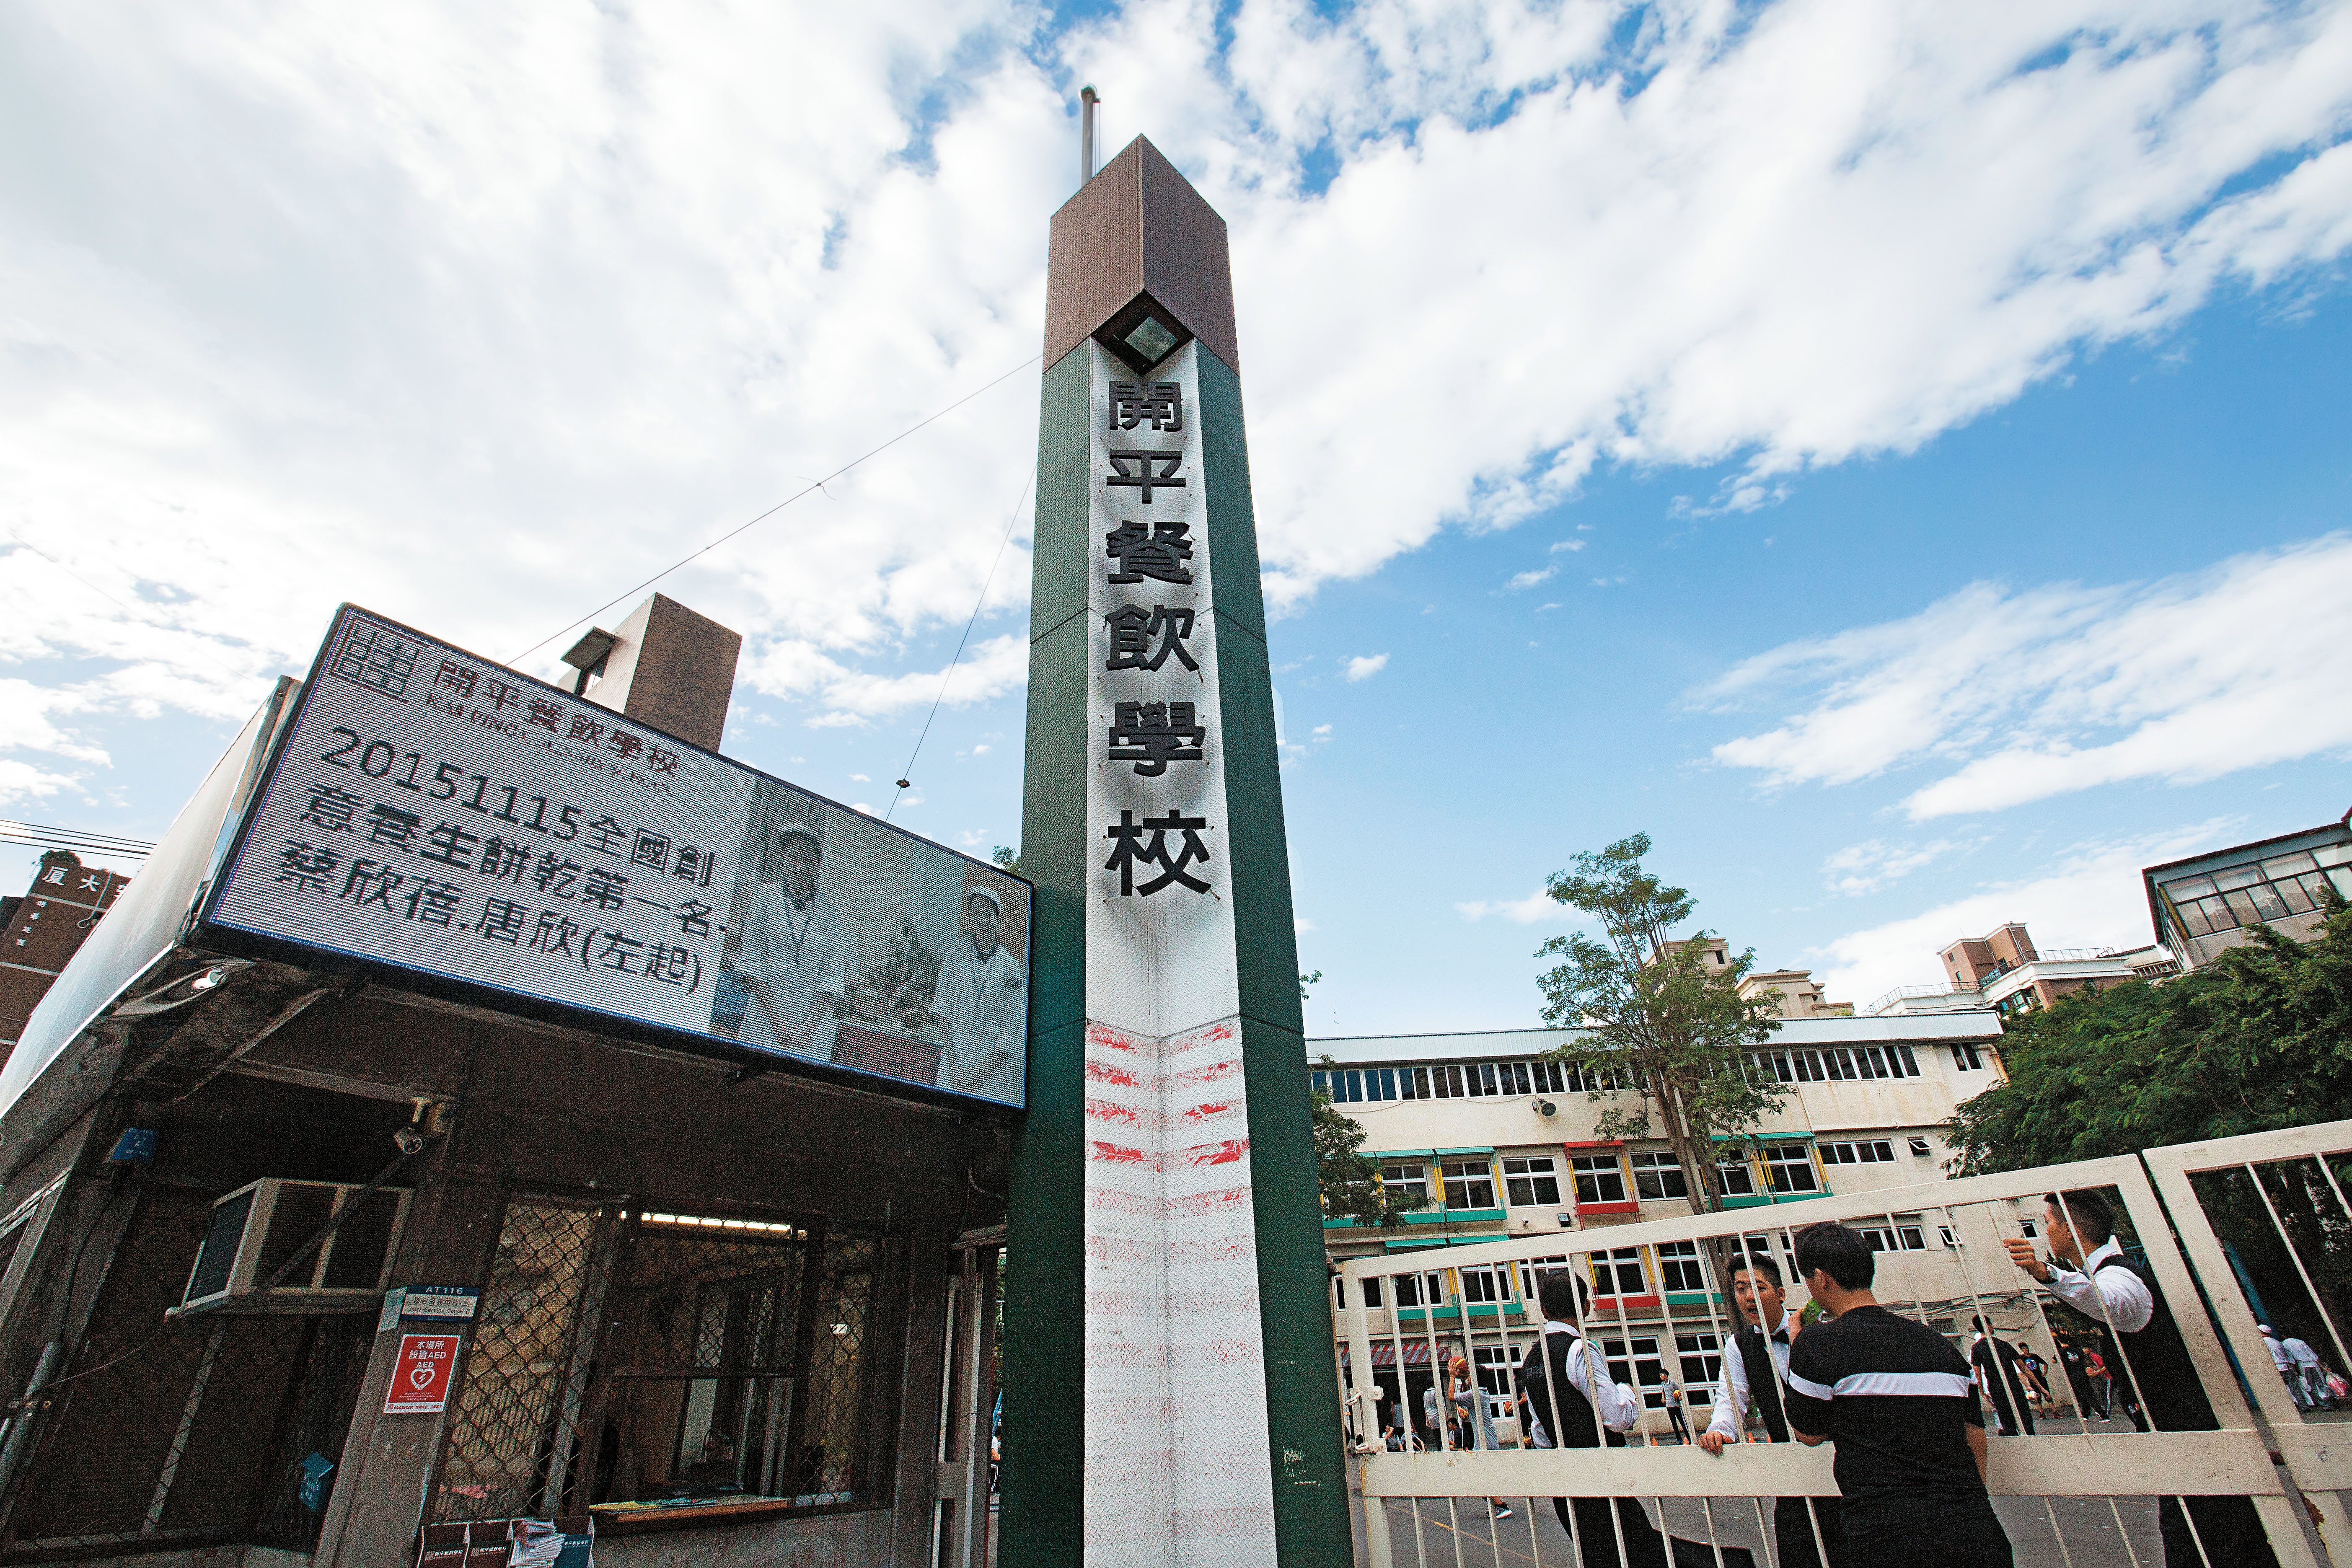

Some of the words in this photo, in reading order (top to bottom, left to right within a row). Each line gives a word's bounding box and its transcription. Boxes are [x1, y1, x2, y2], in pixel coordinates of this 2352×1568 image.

[1105, 380, 1211, 897] 開平餐飲學校
[433, 658, 679, 778] 開平餐飲學校
[320, 726, 714, 887] 20151115全國創
[409, 1350, 446, 1359] 設置AED
[417, 1340, 444, 1349] 本場所
